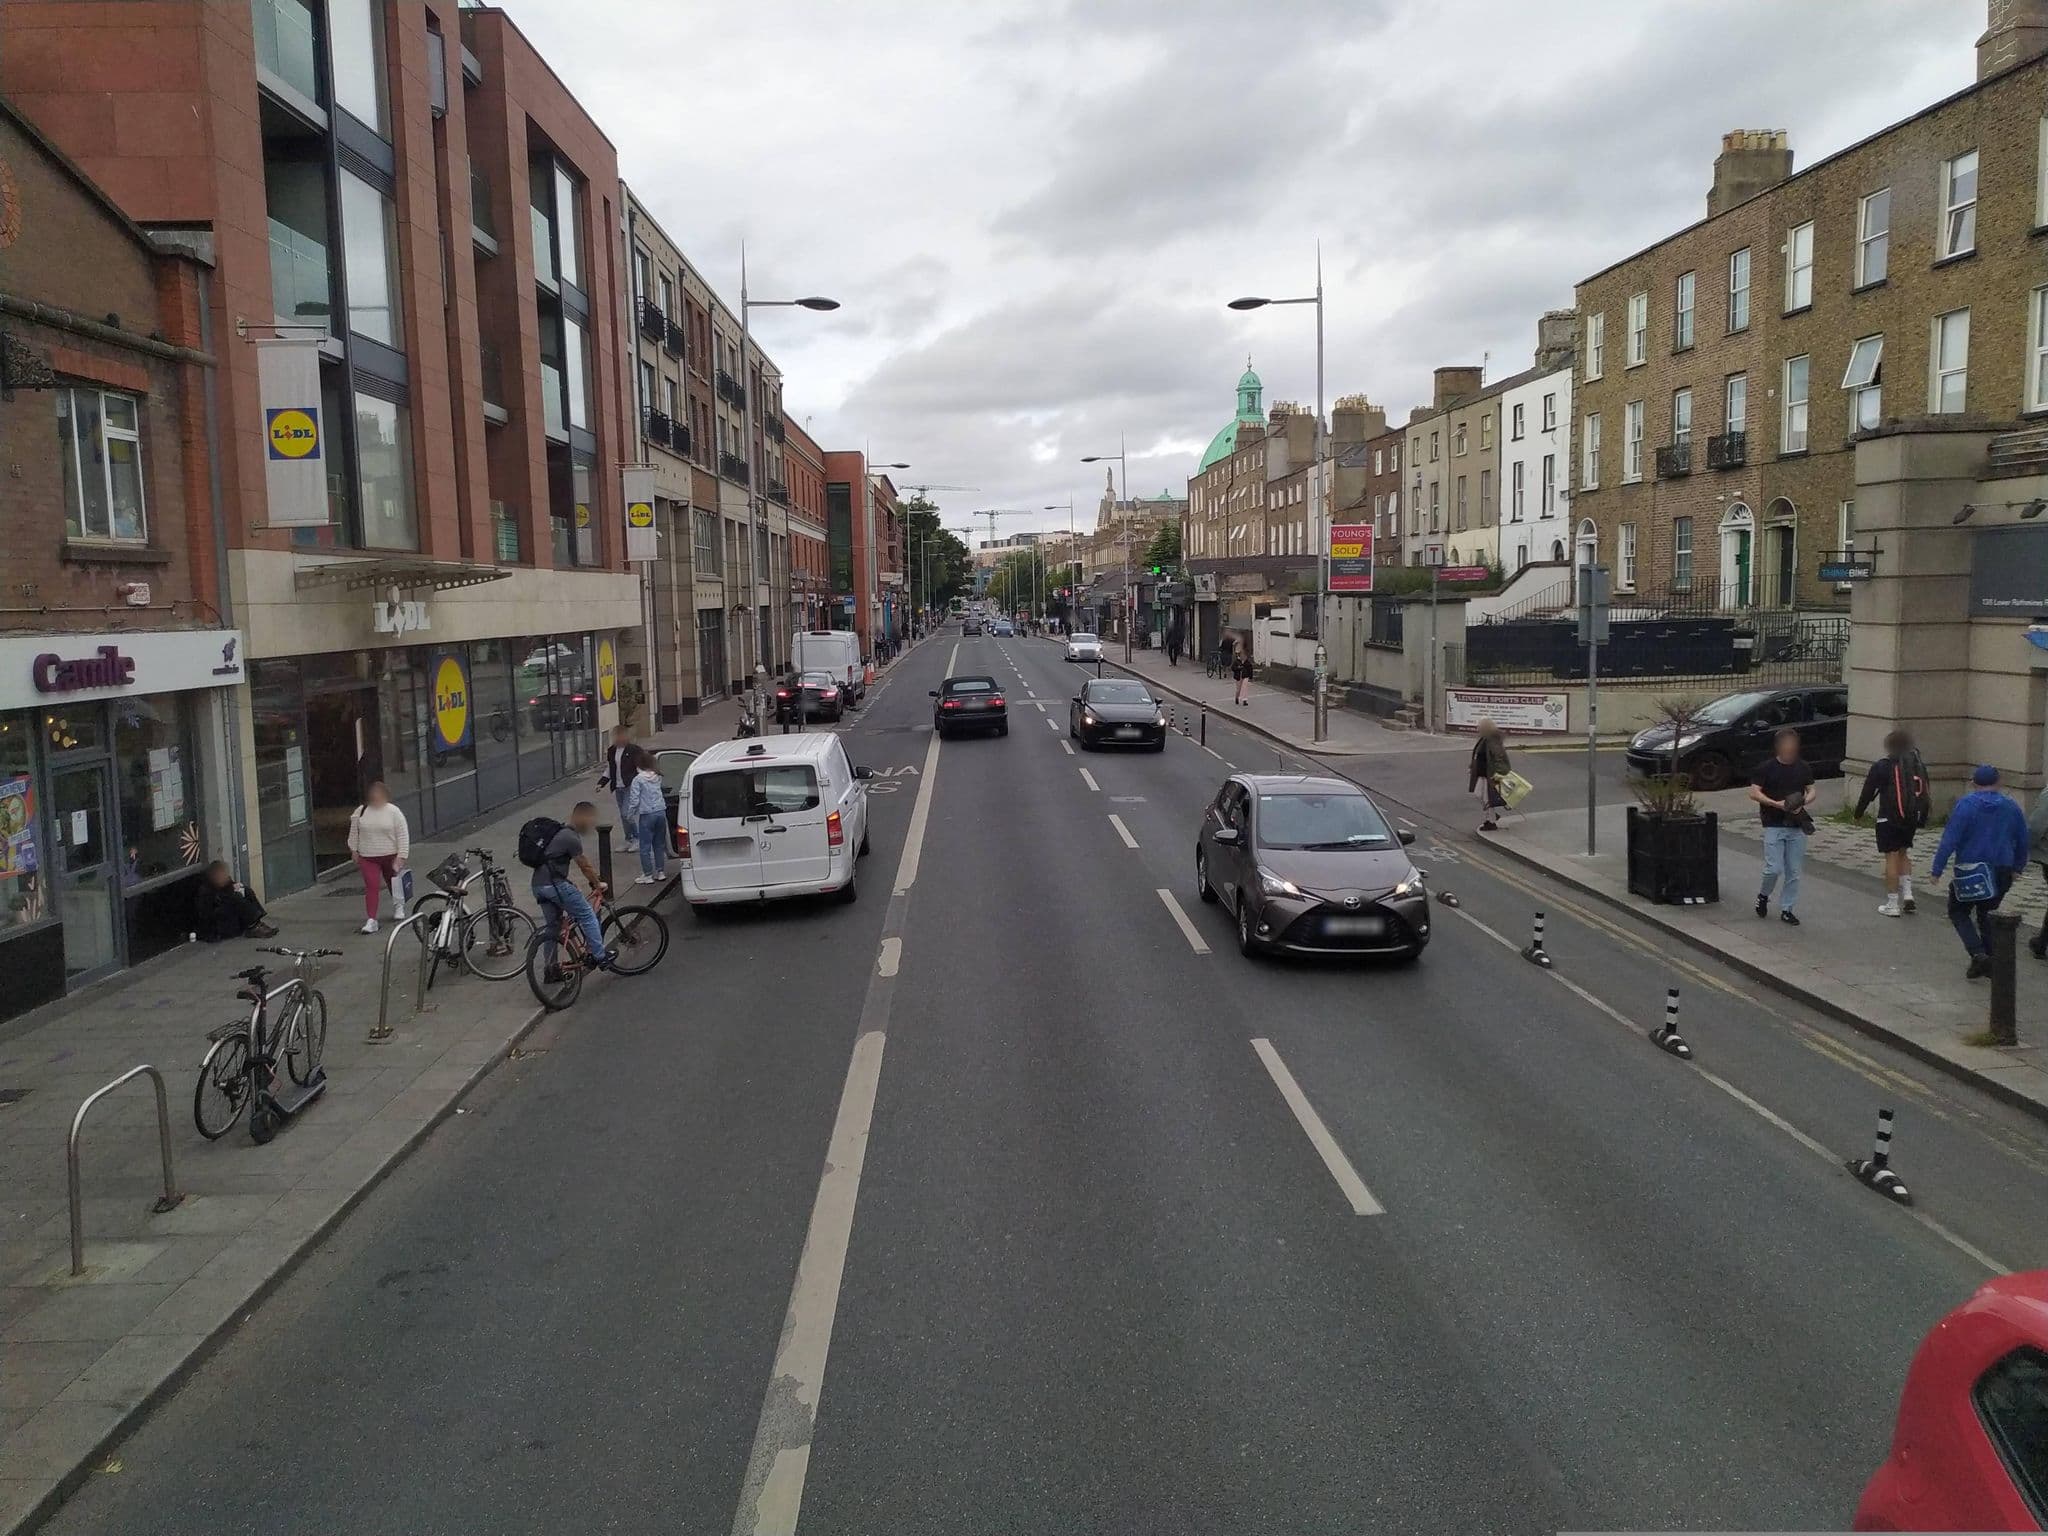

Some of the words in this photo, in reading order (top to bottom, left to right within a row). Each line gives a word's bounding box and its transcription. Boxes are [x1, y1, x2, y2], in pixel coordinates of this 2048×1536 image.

[1332, 529, 1372, 538] YOUNG'S
[1334, 547, 1359, 555] SOLD
[1489, 696, 1519, 704] SPORTS
[1520, 697, 1543, 705] CLUB
